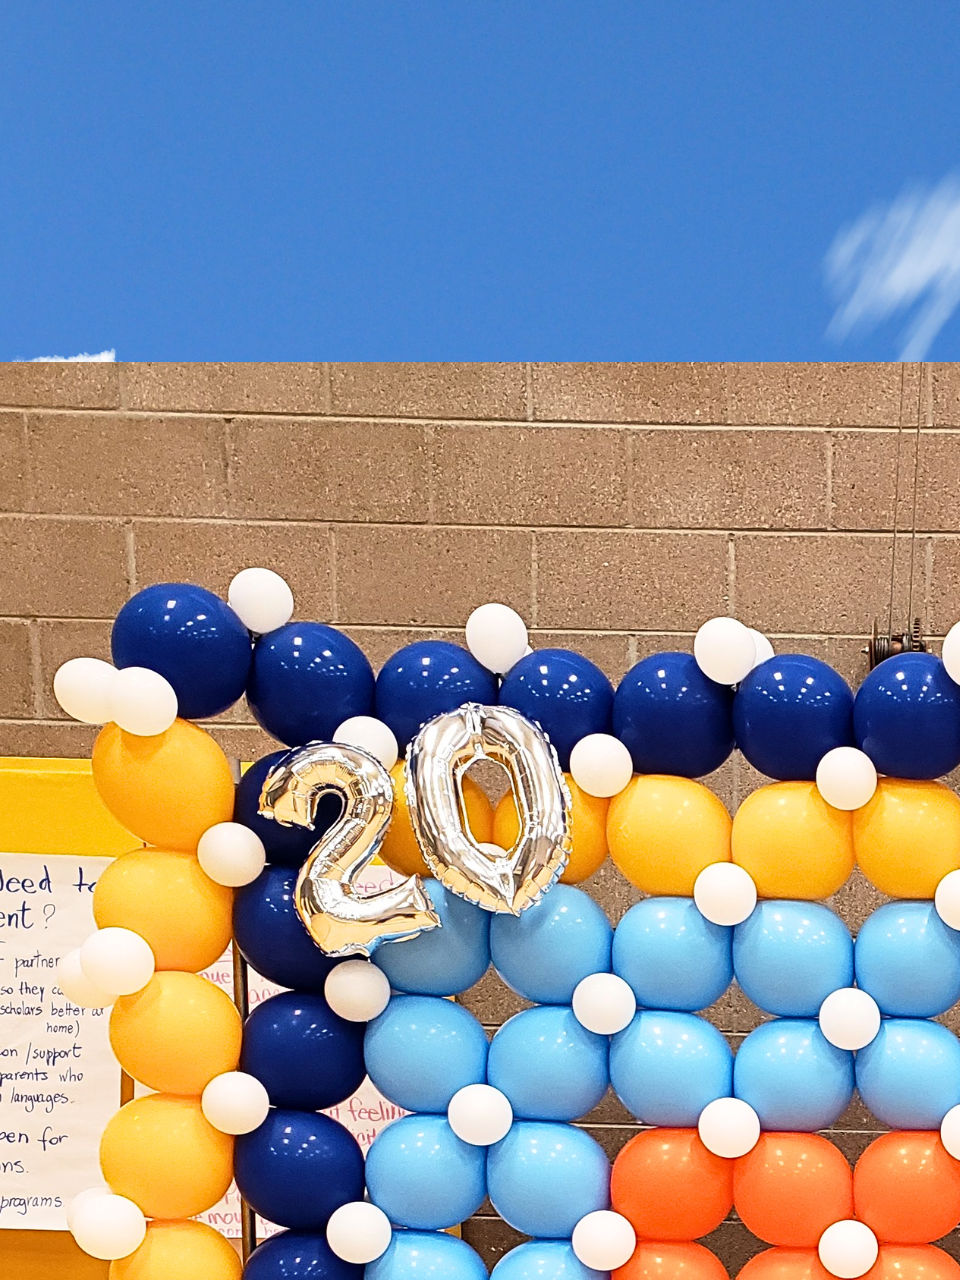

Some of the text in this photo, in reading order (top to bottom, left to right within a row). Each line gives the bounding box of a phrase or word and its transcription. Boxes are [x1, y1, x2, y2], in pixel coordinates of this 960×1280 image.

[14, 949, 61, 978] partner
[0, 985, 14, 996] so
[18, 981, 45, 1003] they
[0, 1000, 43, 1016] scholars
[50, 1001, 86, 1018] better
[46, 1019, 81, 1039] home)
[0, 1066, 84, 1088] parents who
[37, 1125, 69, 1152] for
